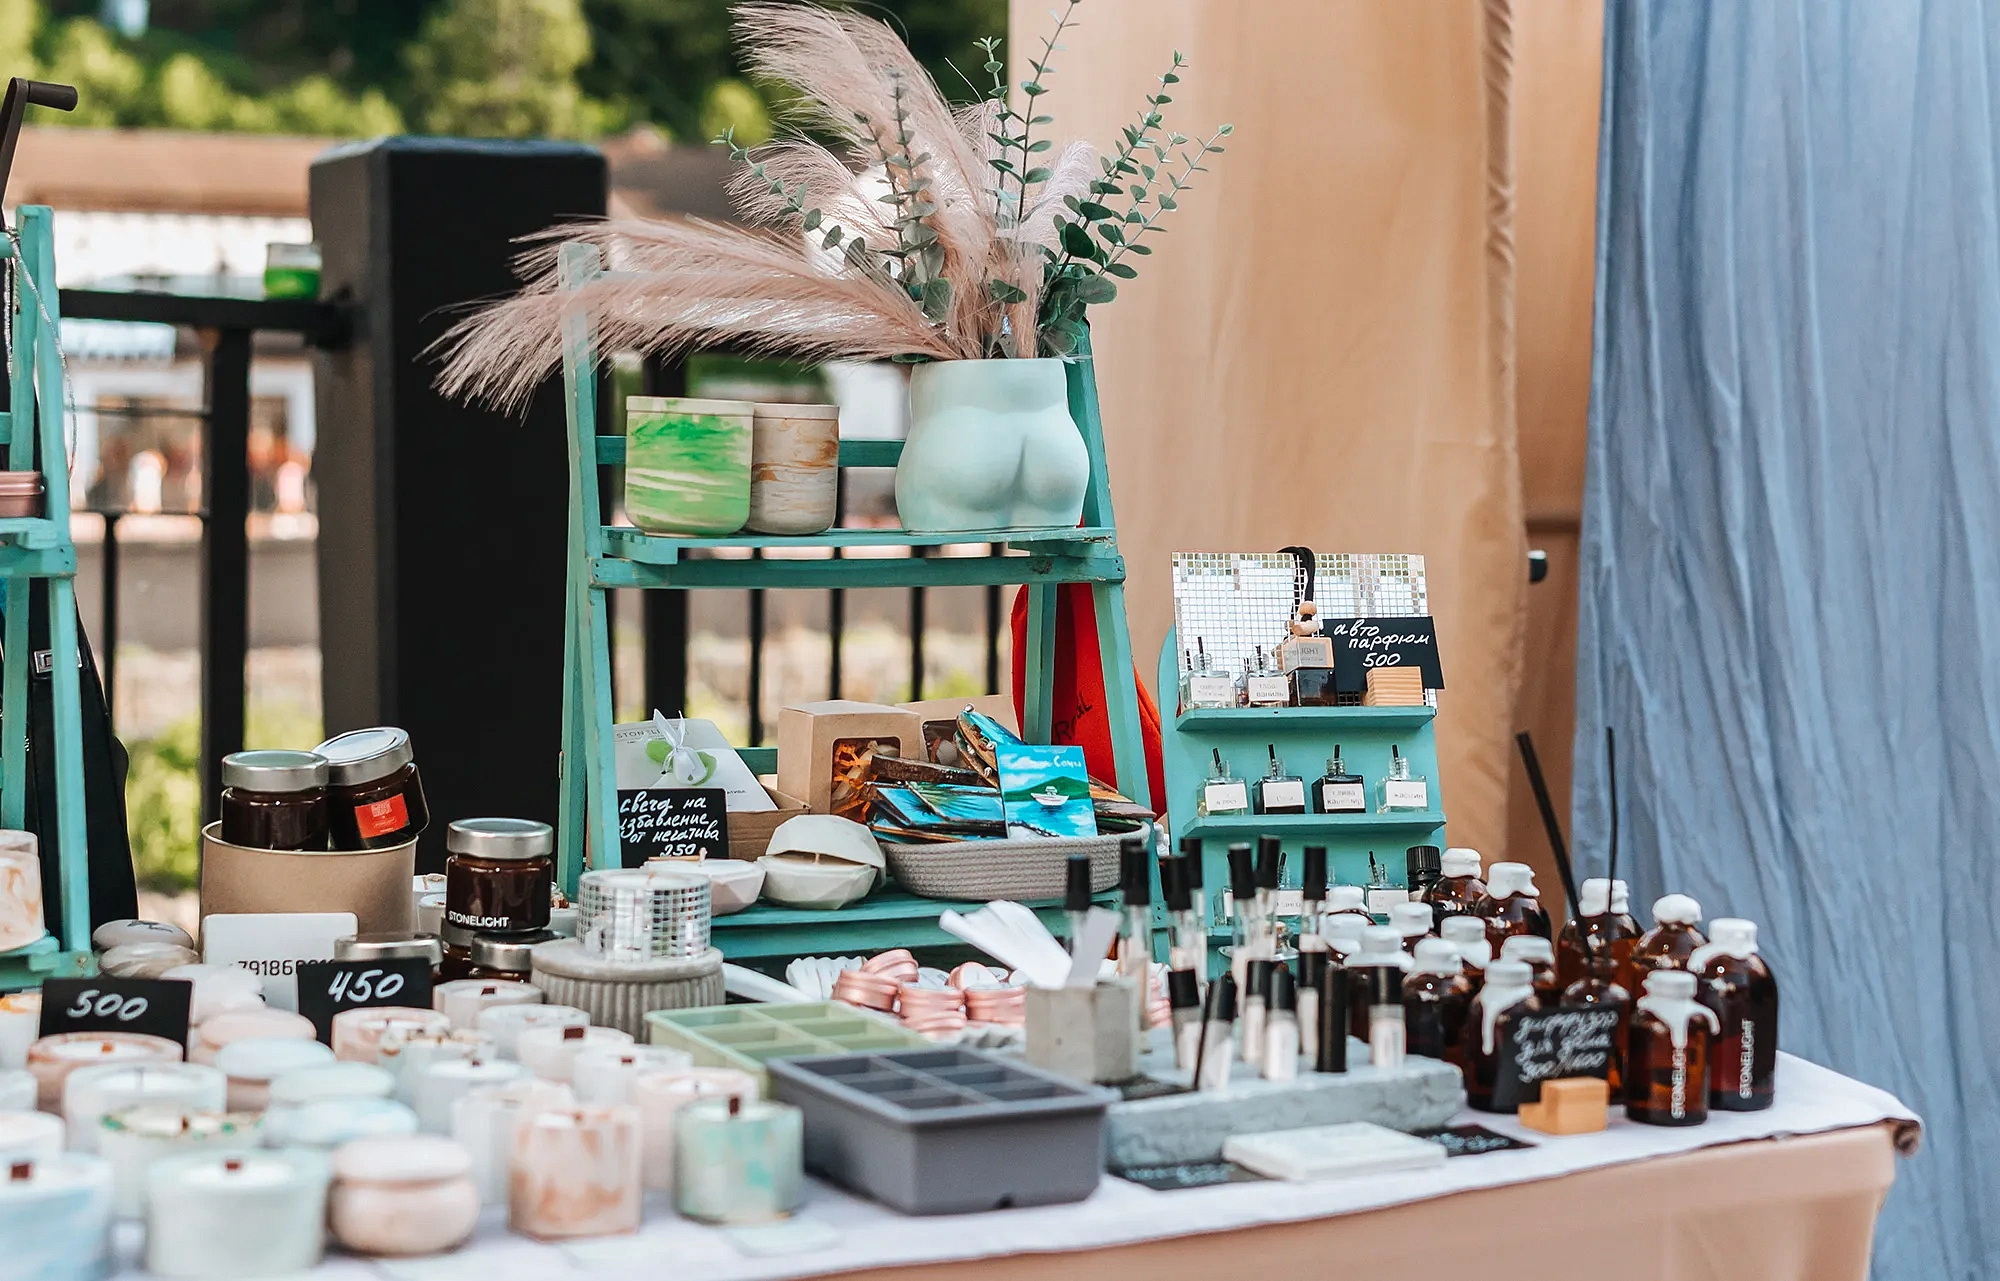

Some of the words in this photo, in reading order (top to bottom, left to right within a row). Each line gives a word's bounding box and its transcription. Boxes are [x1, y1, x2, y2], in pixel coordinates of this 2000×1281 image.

[1333, 619, 1380, 637] авто
[1348, 633, 1430, 651] парфюм
[1362, 653, 1401, 668] 500
[619, 791, 674, 814] свеча
[683, 796, 707, 810] на
[629, 831, 647, 844] от
[652, 820, 720, 843] негатива
[659, 843, 697, 857] 250
[448, 910, 509, 928] STONELIGHT
[328, 968, 405, 1003] 450
[66, 989, 149, 1021] 500
